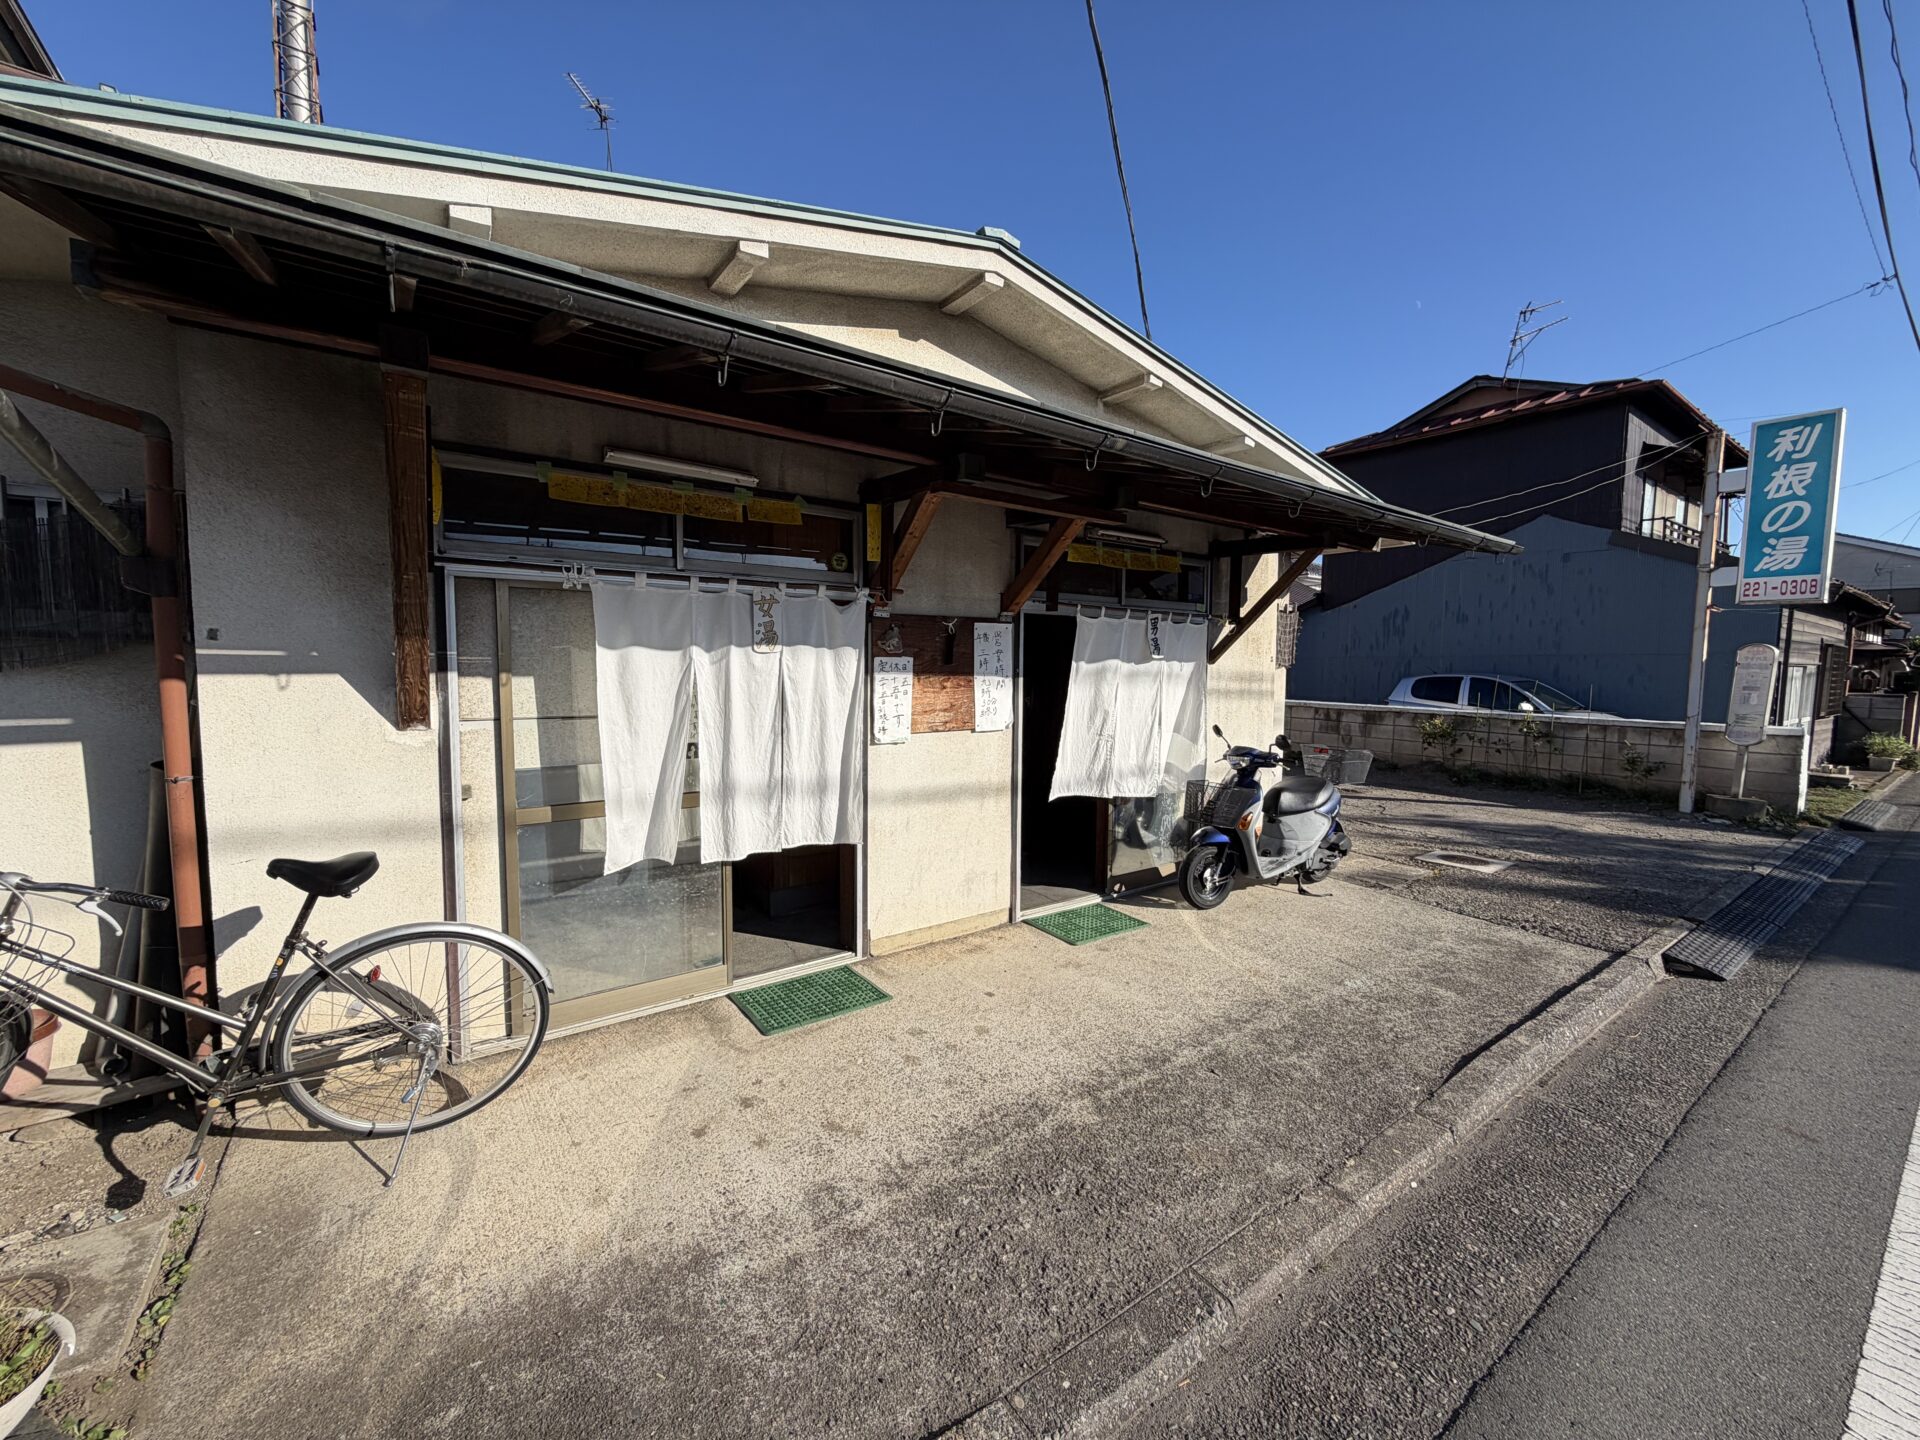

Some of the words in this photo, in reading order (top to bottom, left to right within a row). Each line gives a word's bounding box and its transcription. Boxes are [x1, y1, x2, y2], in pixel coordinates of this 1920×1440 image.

[1753, 422, 1824, 572] 利根の湯
[1742, 578, 1818, 598] 221-0308
[753, 594, 780, 651] 女湯
[1150, 617, 1161, 656] 男湯
[878, 659, 908, 673] 定休日
[991, 631, 1006, 690] 営業時間
